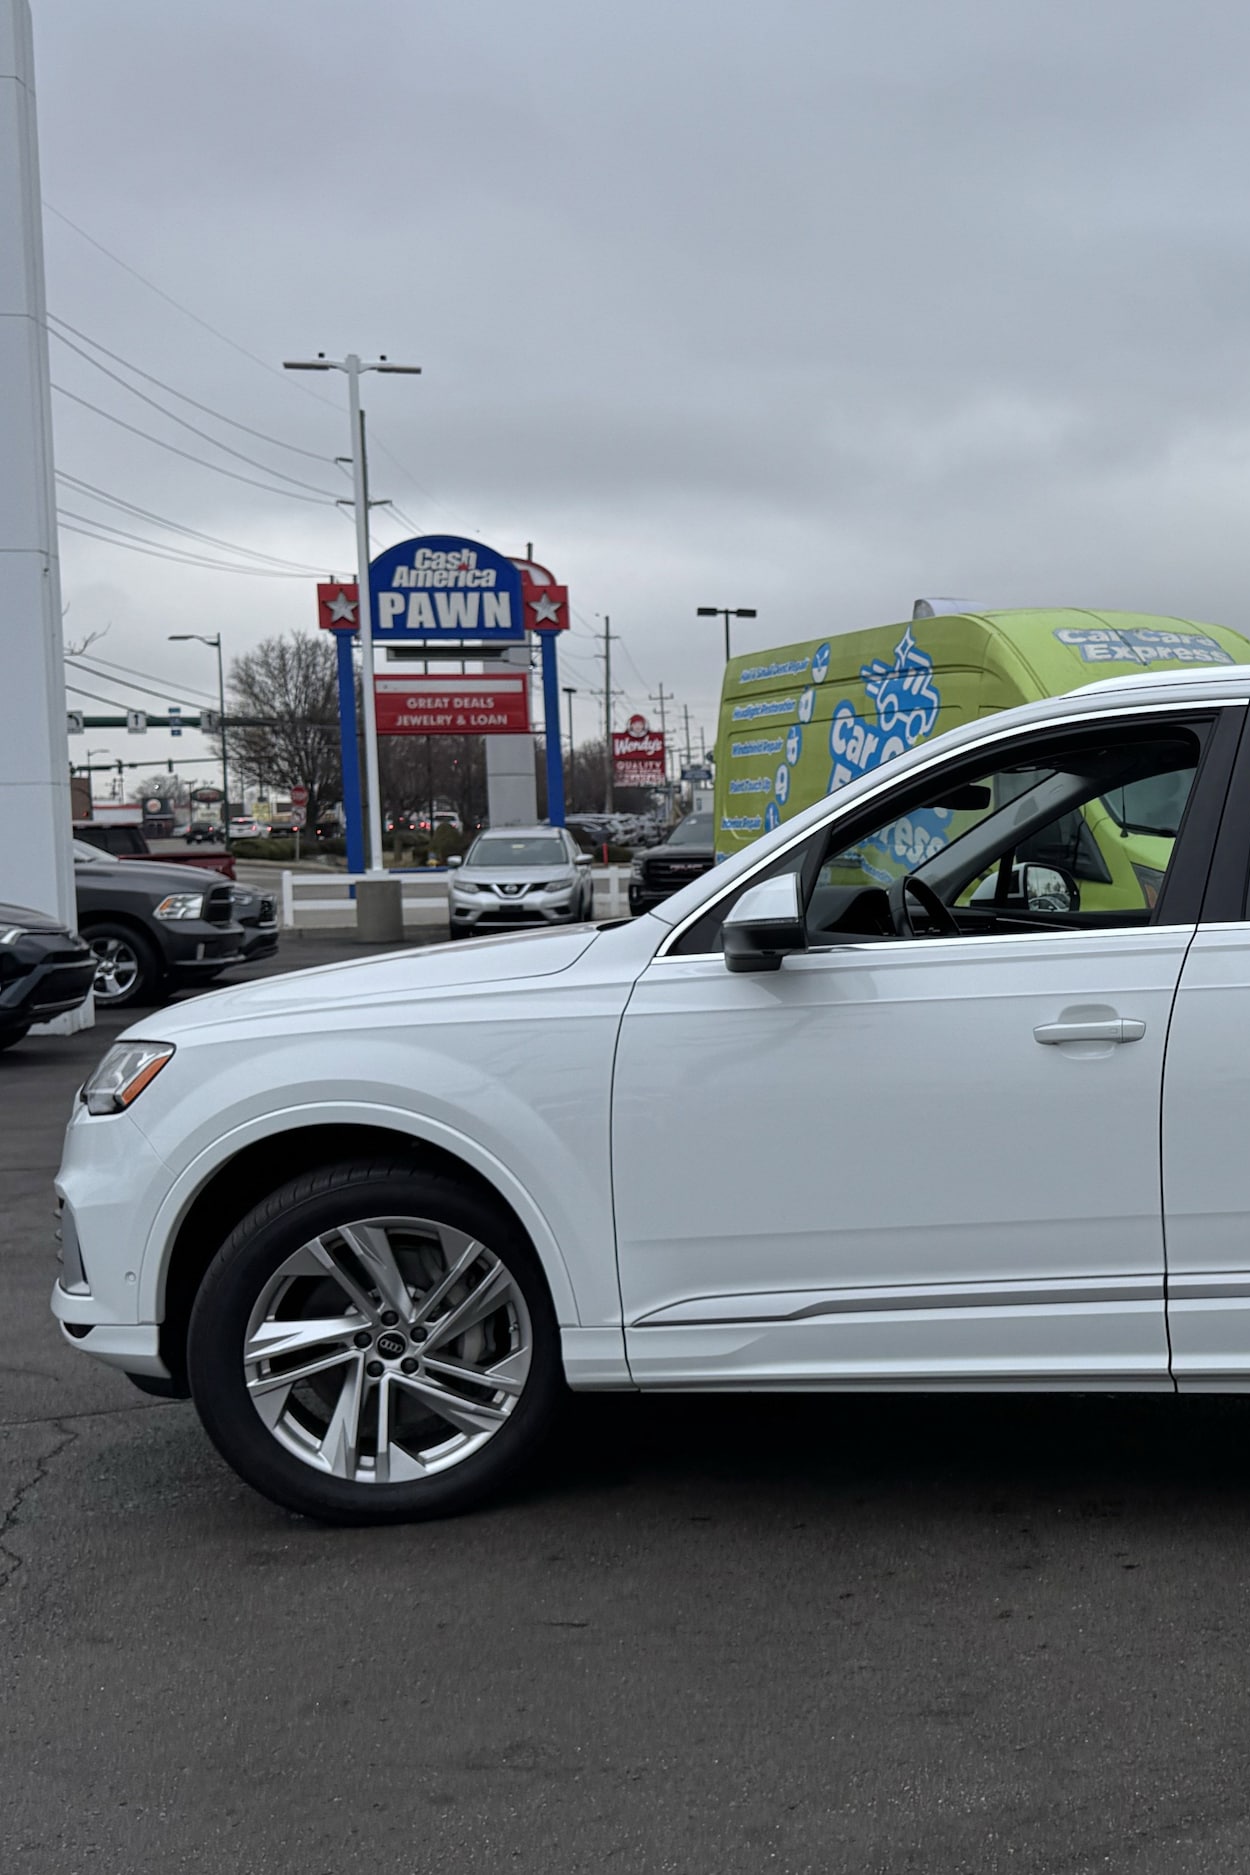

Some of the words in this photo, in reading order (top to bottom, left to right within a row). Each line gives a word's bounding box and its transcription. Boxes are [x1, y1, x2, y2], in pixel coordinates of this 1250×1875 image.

[414, 548, 477, 571] Cash
[392, 565, 497, 588] America
[378, 592, 511, 629] PAWN
[1056, 629, 1121, 645] Car
[1136, 628, 1215, 649] Care
[1085, 643, 1229, 664] Express
[406, 697, 449, 709] GREAT
[453, 697, 495, 709] DEALS
[396, 715, 452, 727] JEWELRY
[456, 715, 466, 726] &
[470, 714, 508, 726] LOAN
[832, 707, 879, 769] Car
[616, 760, 662, 771] QUALITY
